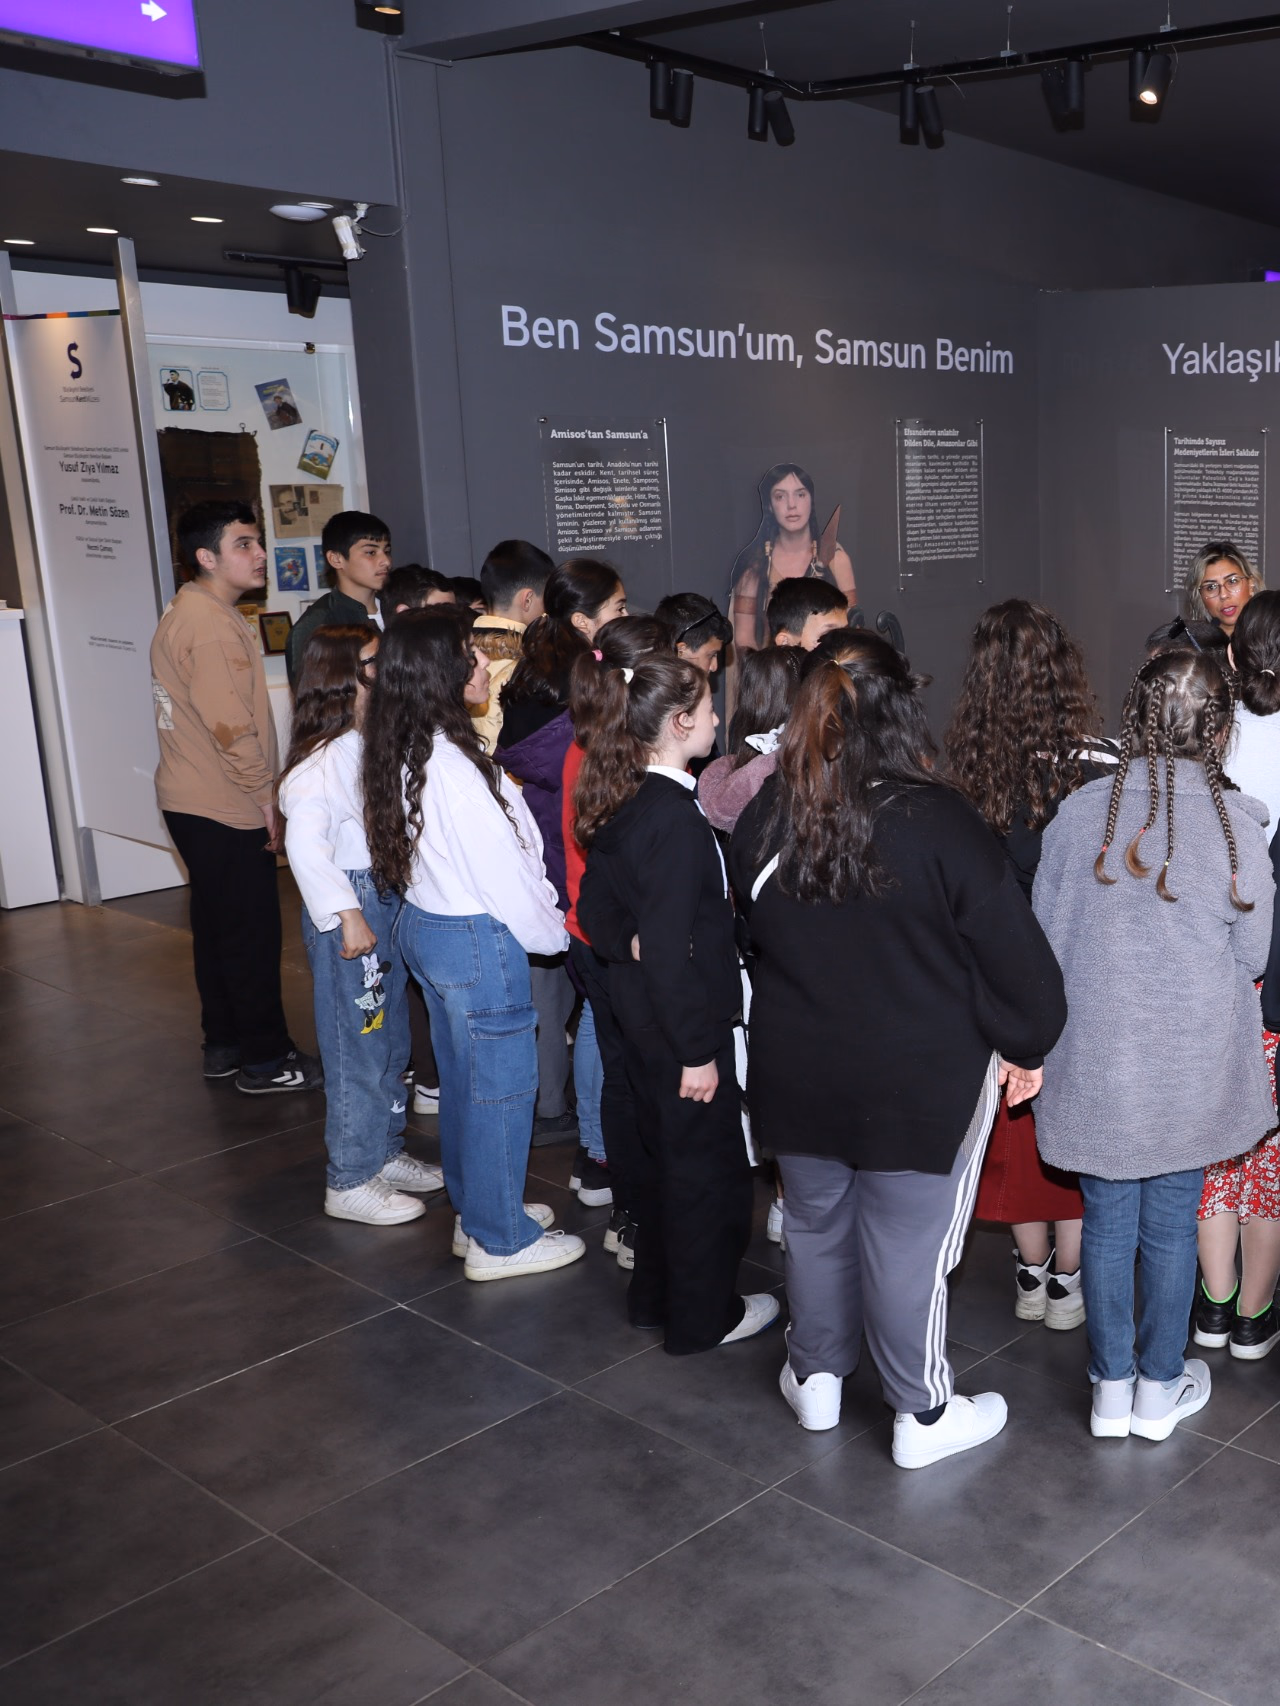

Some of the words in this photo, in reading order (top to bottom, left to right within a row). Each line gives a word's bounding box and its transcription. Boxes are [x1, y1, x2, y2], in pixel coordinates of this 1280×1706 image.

[501, 304, 579, 350] Ben
[594, 312, 803, 369] Samsun'um,
[814, 328, 926, 369] Samsun
[936, 338, 1014, 374] Benim
[550, 429, 604, 439] Amisos'tan
[606, 429, 648, 439] Samsun'a
[59, 461, 79, 473] Yusuf
[80, 461, 95, 475] Ziya
[96, 462, 119, 474] Yılmaz
[59, 503, 76, 515] Prof.
[77, 504, 88, 516] Dr.
[89, 505, 108, 517] Metin
[109, 506, 130, 519] Sözen
